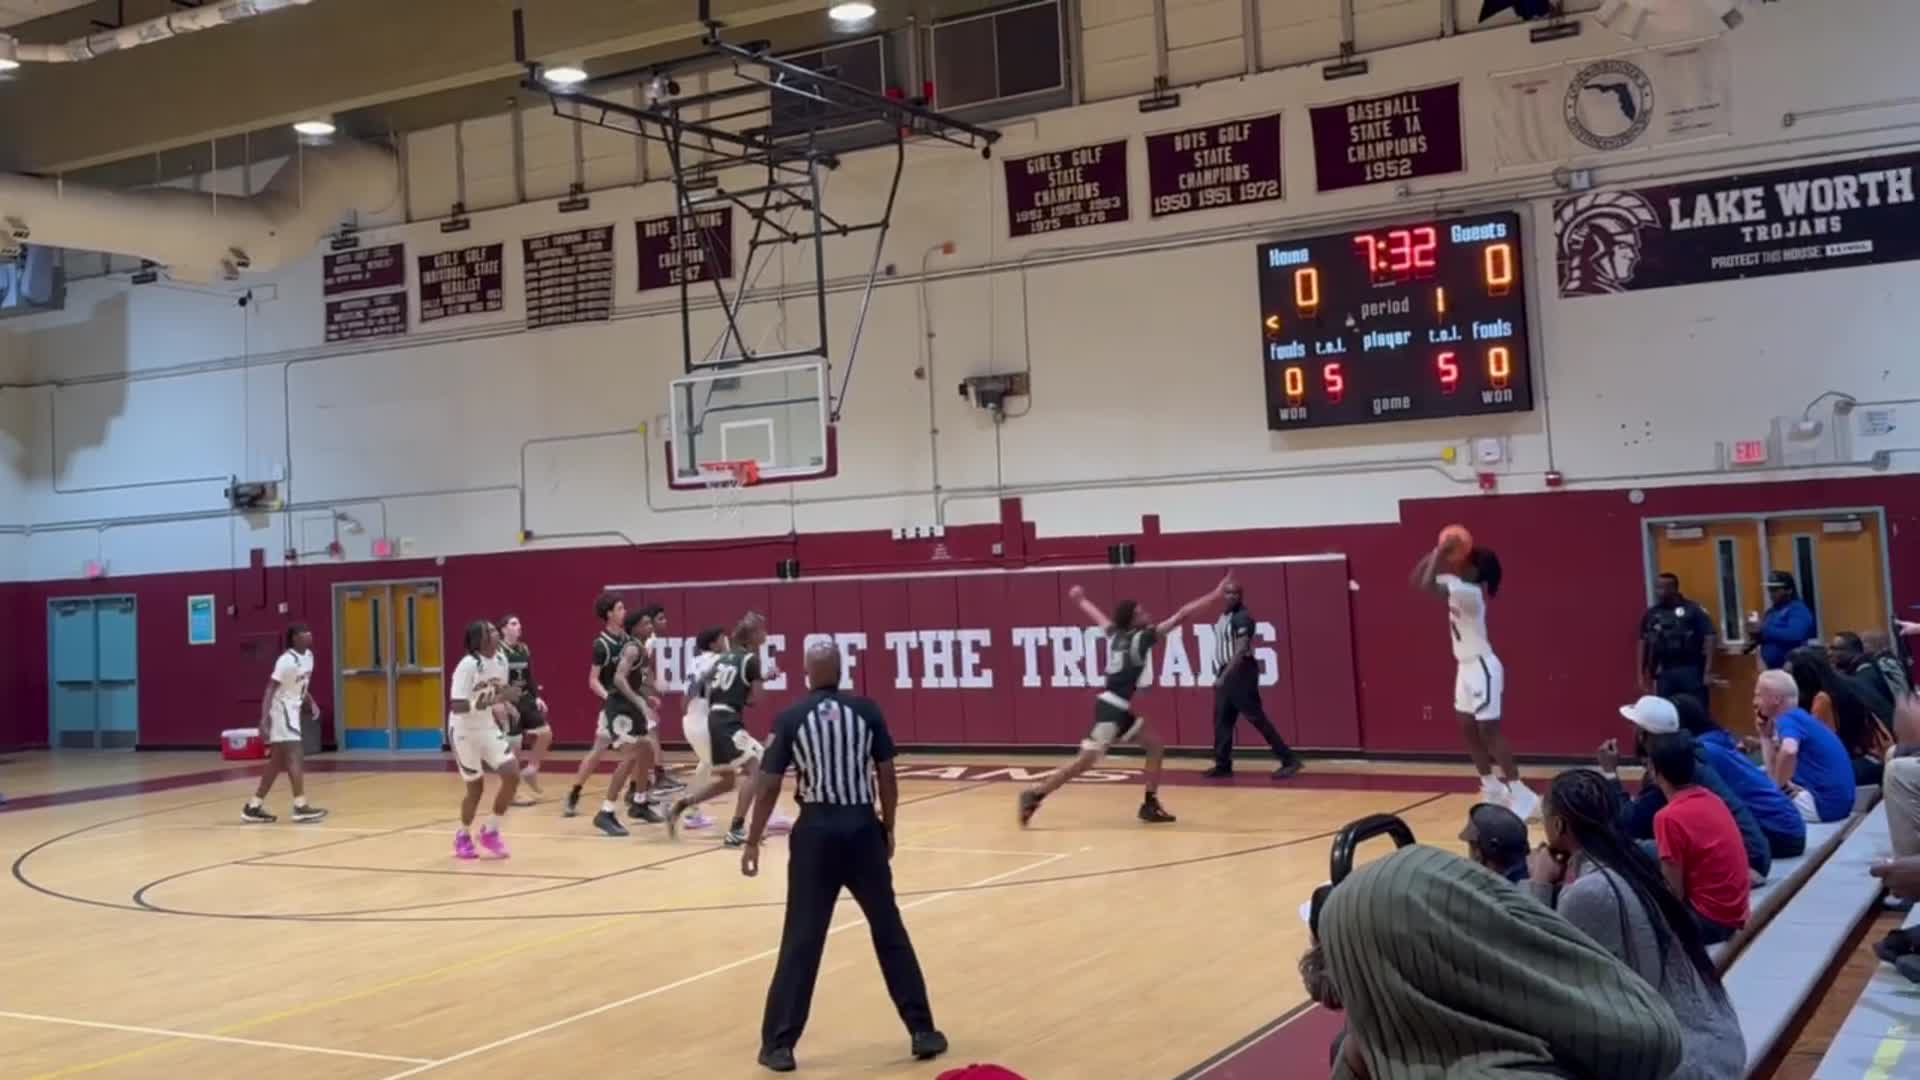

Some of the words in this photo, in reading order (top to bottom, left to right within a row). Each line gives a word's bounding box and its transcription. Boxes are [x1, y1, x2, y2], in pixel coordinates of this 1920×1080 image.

[1346, 96, 1421, 123] BASEBALL
[1174, 131, 1207, 152] BOYS
[1218, 123, 1251, 144] GOLF
[1350, 119, 1393, 143] STATE
[1405, 115, 1422, 134] 1A
[1026, 154, 1062, 175] GIRLS
[1071, 147, 1103, 167] GOLF
[1194, 146, 1233, 168] STATE
[1347, 135, 1428, 163] CHAMPIONS
[1048, 167, 1084, 188] STATE
[1178, 164, 1250, 190] CHAMPIONS
[1365, 158, 1413, 181] 1952
[1034, 182, 1100, 207] CHAMPIONS
[1154, 192, 1191, 214] 1950
[1198, 186, 1232, 207] 1951
[1240, 180, 1279, 201] 1972
[1668, 186, 1766, 231] LAKE
[1775, 167, 1914, 217] WORTH
[1740, 215, 1842, 243] TROJANS
[1269, 248, 1309, 267] Home
[1451, 222, 1506, 243] Guests
[1354, 227, 1437, 271] 7:32
[1295, 267, 1319, 306] 0
[1485, 244, 1512, 285] 0
[1711, 253, 1759, 270] PROTECT
[1361, 297, 1410, 319] period
[1436, 287, 1445, 313] 1
[1363, 330, 1412, 351] player
[1472, 318, 1512, 340] fouls
[1270, 341, 1306, 360] fouls
[1437, 352, 1458, 382] 5
[1488, 347, 1509, 377] 0
[1285, 367, 1303, 395] 0
[1323, 363, 1343, 392] 5
[1279, 407, 1307, 420] won
[1373, 397, 1411, 415] game
[1481, 389, 1512, 403] won
[885, 629, 993, 689] THE
